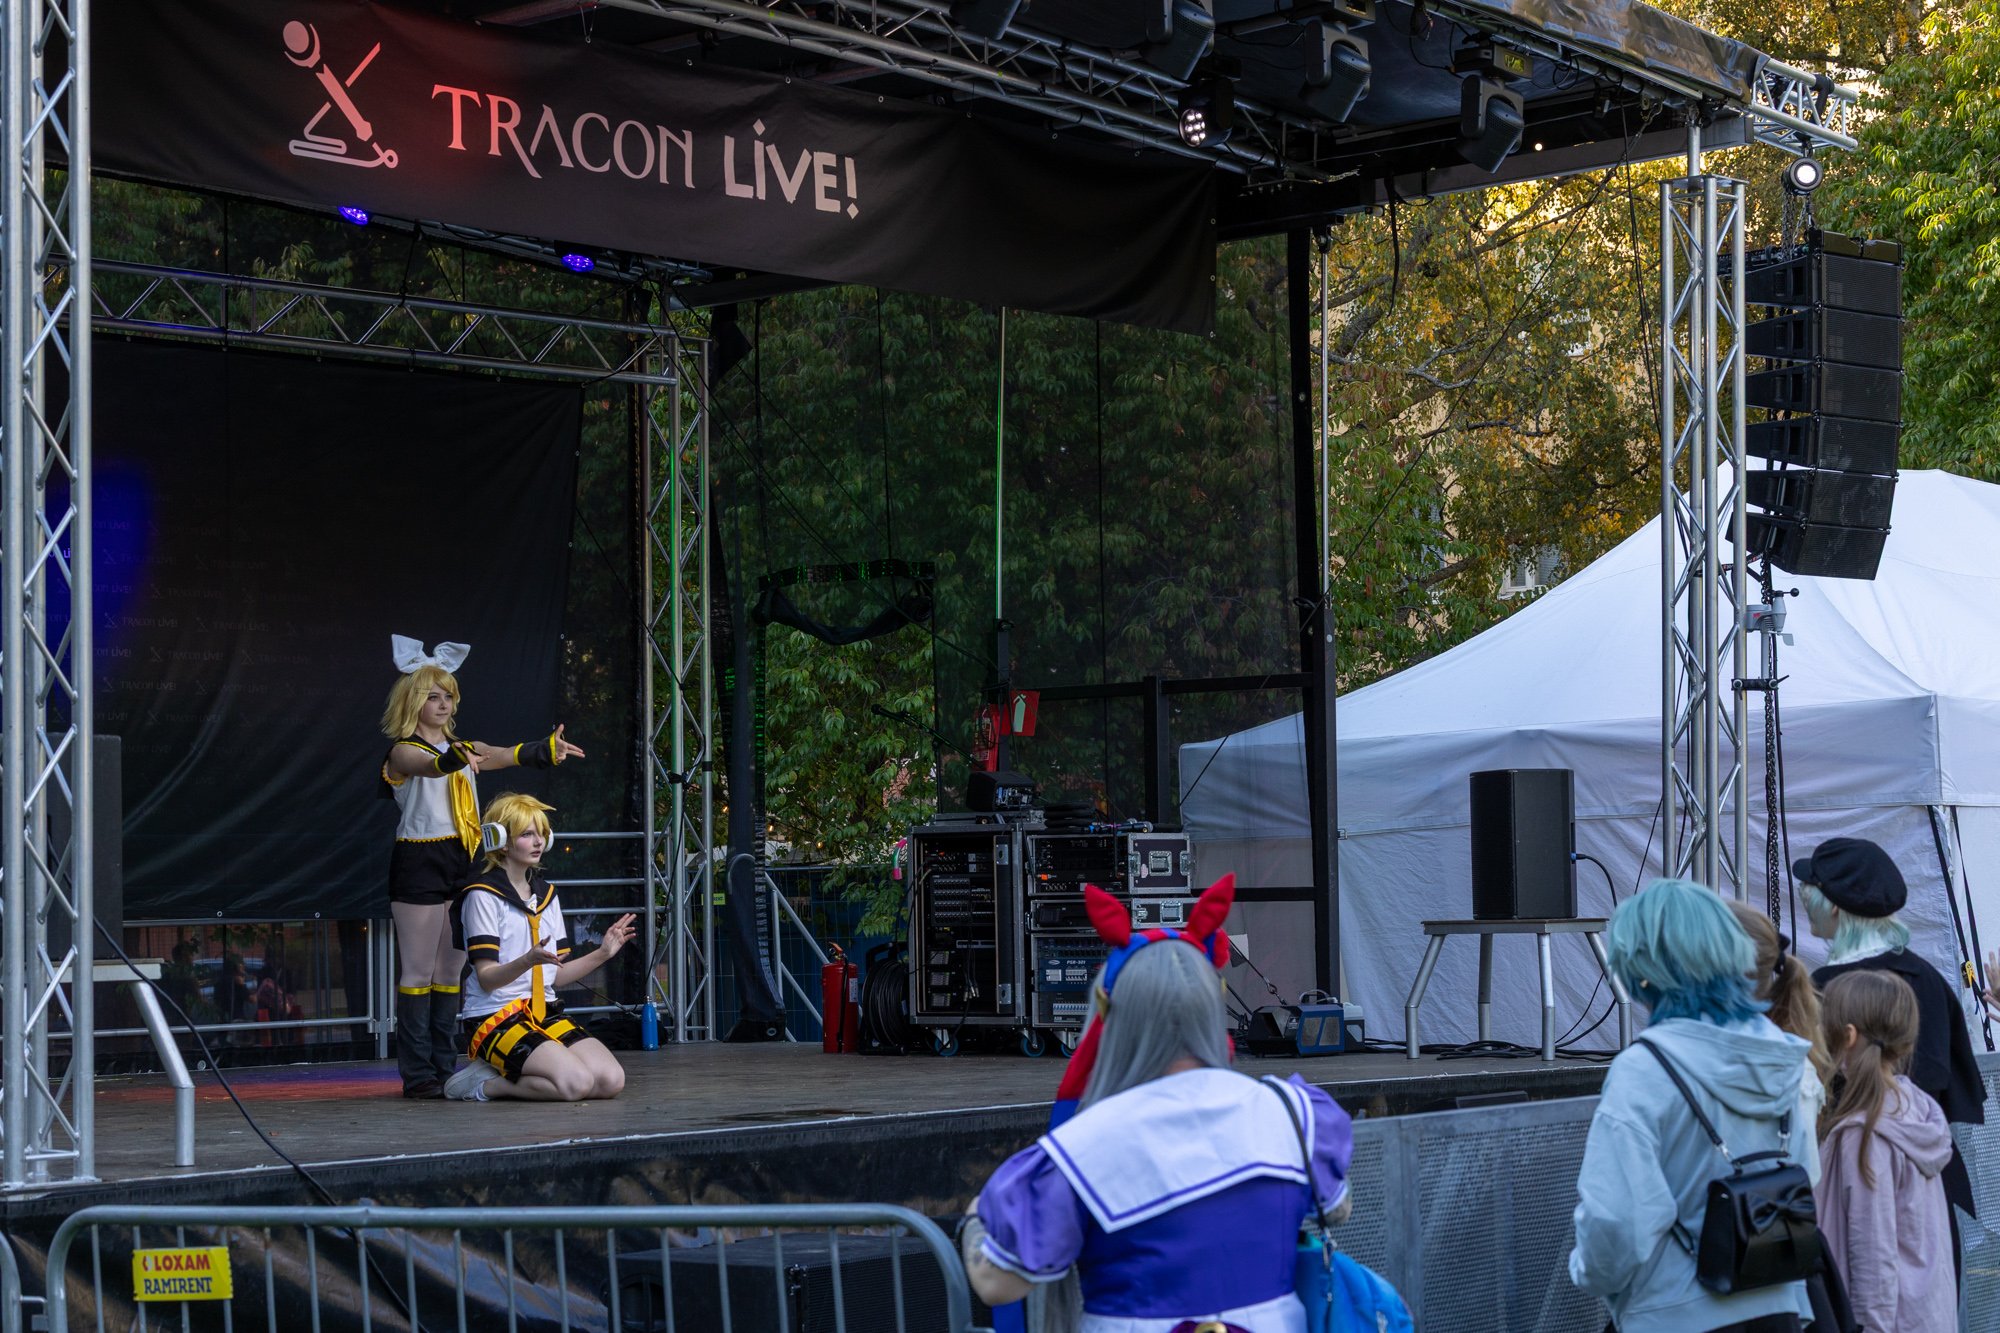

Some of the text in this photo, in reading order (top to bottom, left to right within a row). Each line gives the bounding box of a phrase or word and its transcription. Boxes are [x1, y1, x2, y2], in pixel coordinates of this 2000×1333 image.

[432, 84, 695, 188] TRACON
[154, 1254, 211, 1271] LOXAM
[144, 1277, 213, 1294] RAMIRENT
